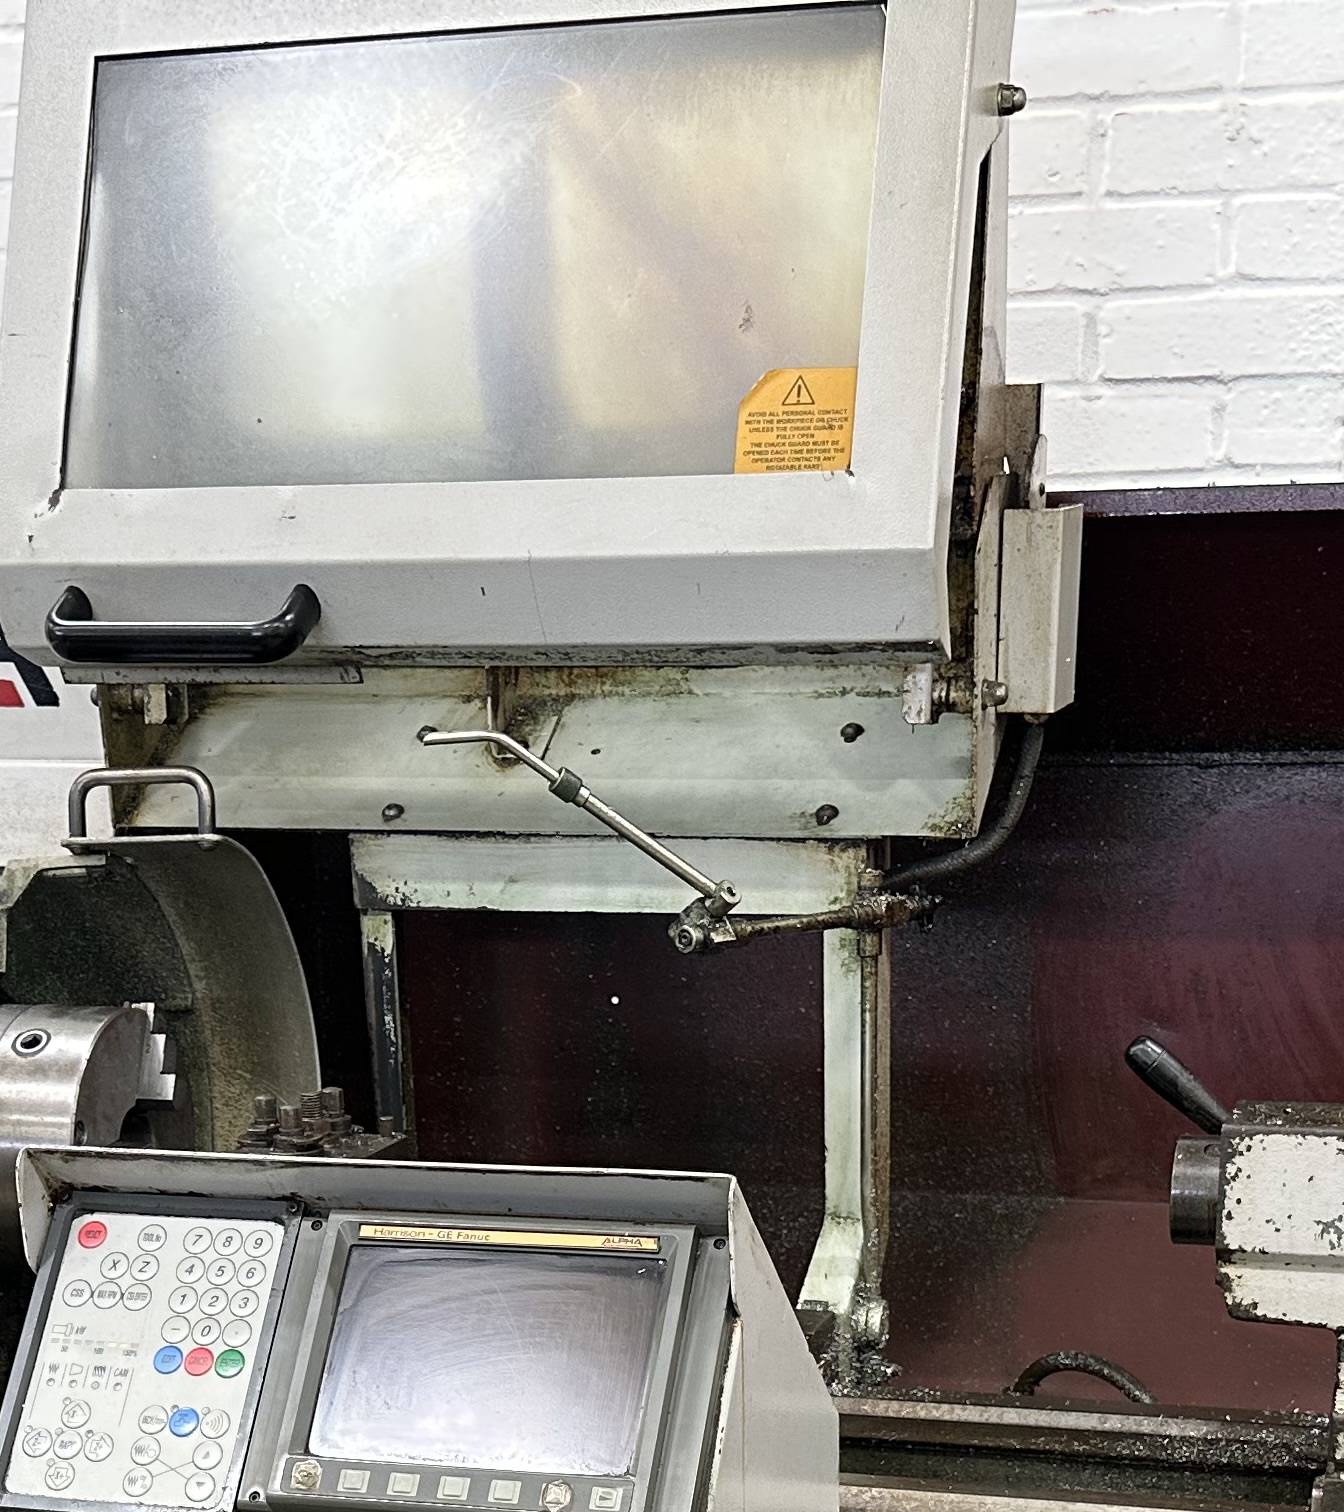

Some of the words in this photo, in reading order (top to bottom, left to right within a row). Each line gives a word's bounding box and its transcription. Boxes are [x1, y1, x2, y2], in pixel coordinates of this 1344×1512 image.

[192, 1234, 203, 1245] 7
[373, 1227, 426, 1238] Harrison
[437, 1230, 453, 1240] GE
[456, 1231, 491, 1241] Fanuc
[222, 1236, 233, 1248] 8
[253, 1237, 264, 1249] 9
[601, 1237, 643, 1247] ALPHA
[108, 1260, 120, 1271] X
[138, 1262, 150, 1273] Z
[185, 1264, 195, 1275] 4
[215, 1266, 225, 1277] 5
[245, 1267, 256, 1279] 6
[179, 1294, 187, 1305] 1
[208, 1296, 219, 1307] 2
[238, 1297, 249, 1309] 3
[201, 1326, 211, 1337] 0
